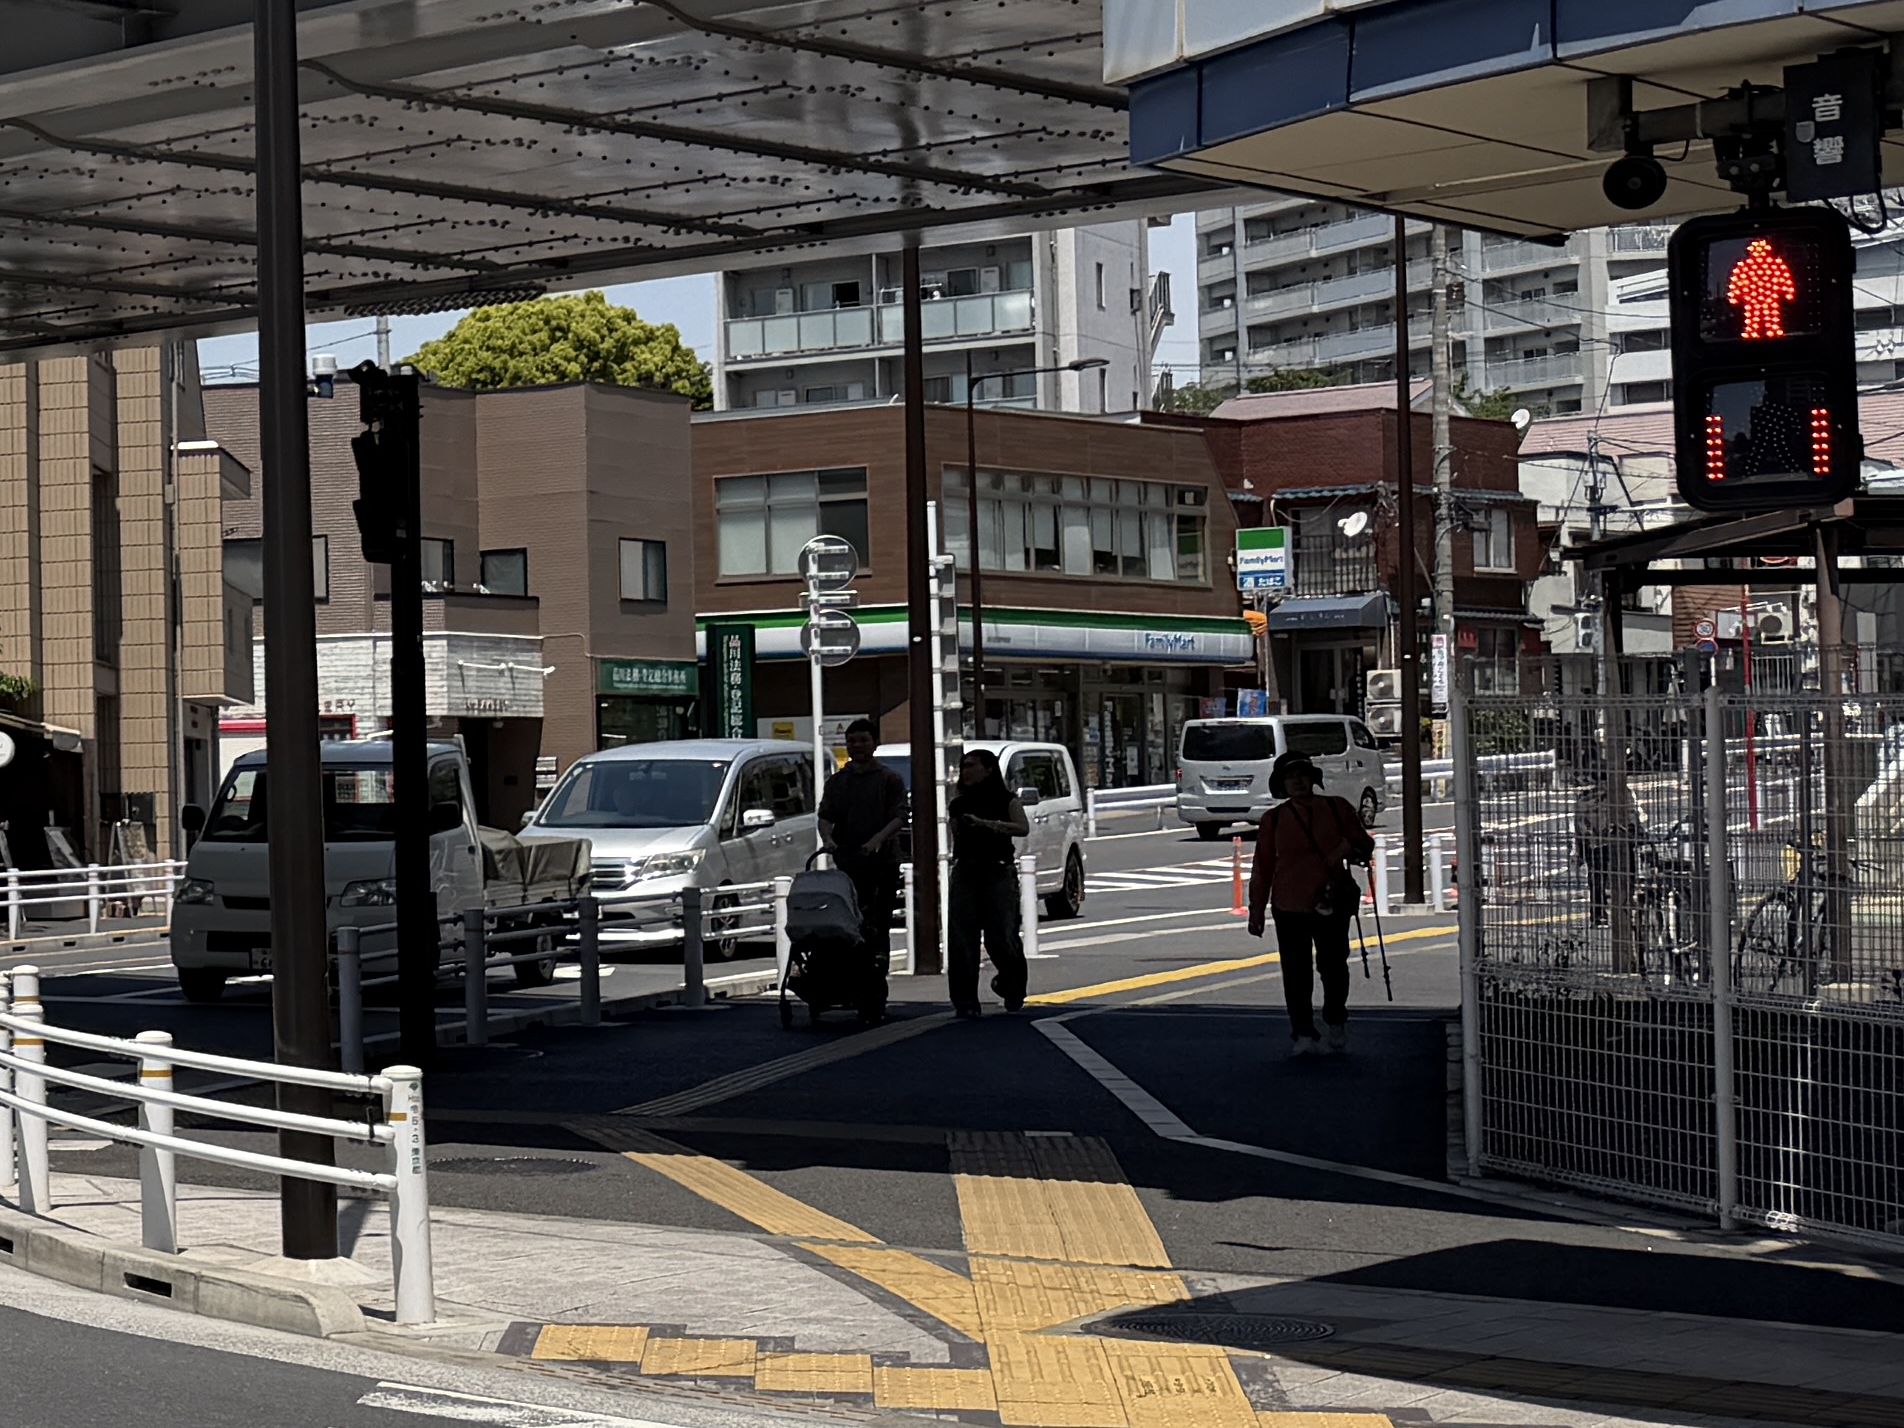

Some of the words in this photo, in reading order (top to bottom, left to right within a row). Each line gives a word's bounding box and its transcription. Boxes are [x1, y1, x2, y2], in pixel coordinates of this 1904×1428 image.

[1812, 93, 1844, 165] 音響
[1239, 556, 1283, 565] FamilyMart
[1145, 633, 1195, 652] FamilyMart
